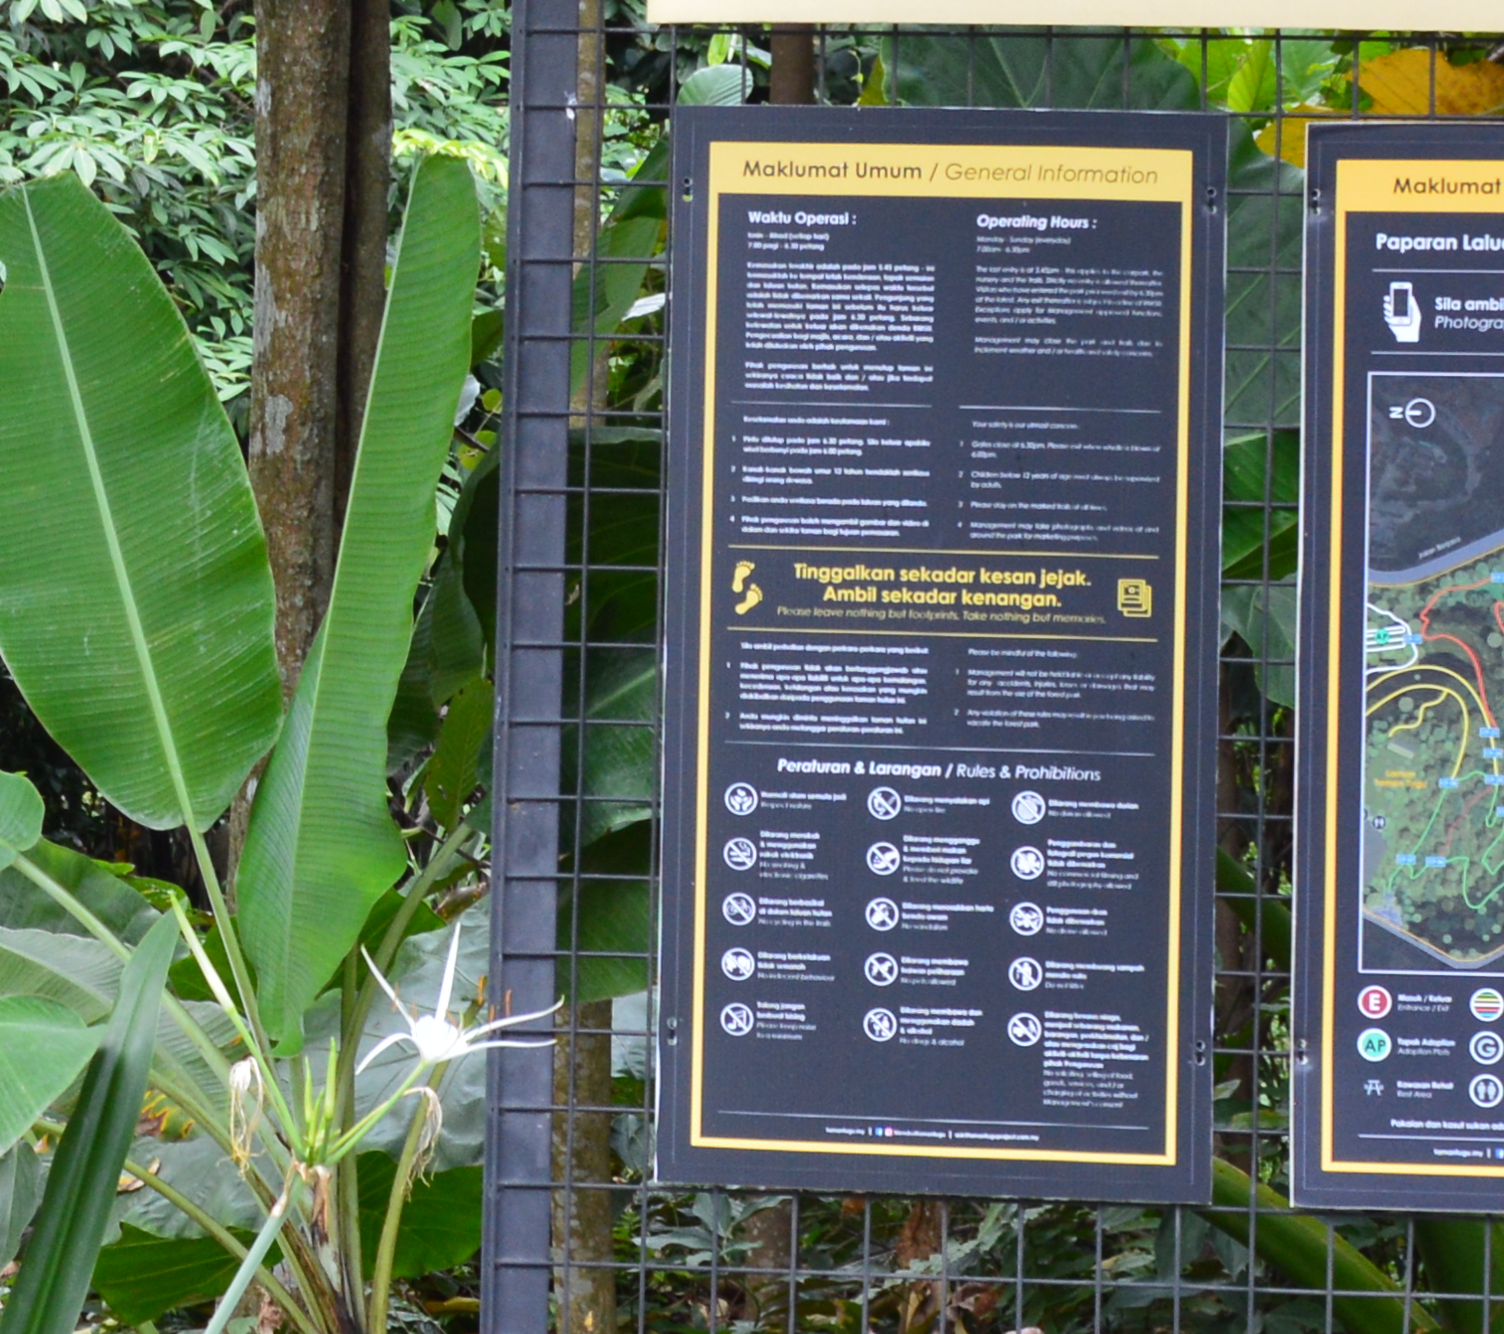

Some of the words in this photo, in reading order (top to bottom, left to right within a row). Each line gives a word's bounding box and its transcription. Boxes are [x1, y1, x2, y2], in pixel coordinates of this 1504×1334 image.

[743, 160, 847, 177] Maklumat
[856, 162, 921, 178] Umum
[930, 163, 937, 181] /
[945, 163, 1031, 180] General
[1038, 166, 1157, 183] Information
[1393, 178, 1500, 194] Maklumat
[748, 211, 791, 223] Waktu
[794, 211, 848, 226] Operasi
[976, 214, 1047, 230] Operating
[1050, 216, 1088, 228] Hours
[1376, 233, 1457, 253] Paparan
[1435, 297, 1461, 310] Sila
[794, 563, 894, 584] Tinggalkan
[899, 566, 975, 583] sekadar
[980, 568, 1035, 584] kesan
[1039, 569, 1090, 589] jejak.
[823, 585, 876, 602] Ambil
[881, 587, 956, 604] sekadar
[961, 590, 1061, 609] kenangan.
[777, 758, 850, 773] Peraturan
[853, 760, 865, 774] &
[868, 761, 941, 779] Larangan
[945, 763, 953, 778] /
[956, 763, 995, 777] Rules
[999, 765, 1010, 778] &
[1015, 765, 1100, 780] Prohibitions
[1369, 993, 1381, 1011] E
[1365, 1039, 1386, 1052] AP
[1477, 1038, 1496, 1056] G
